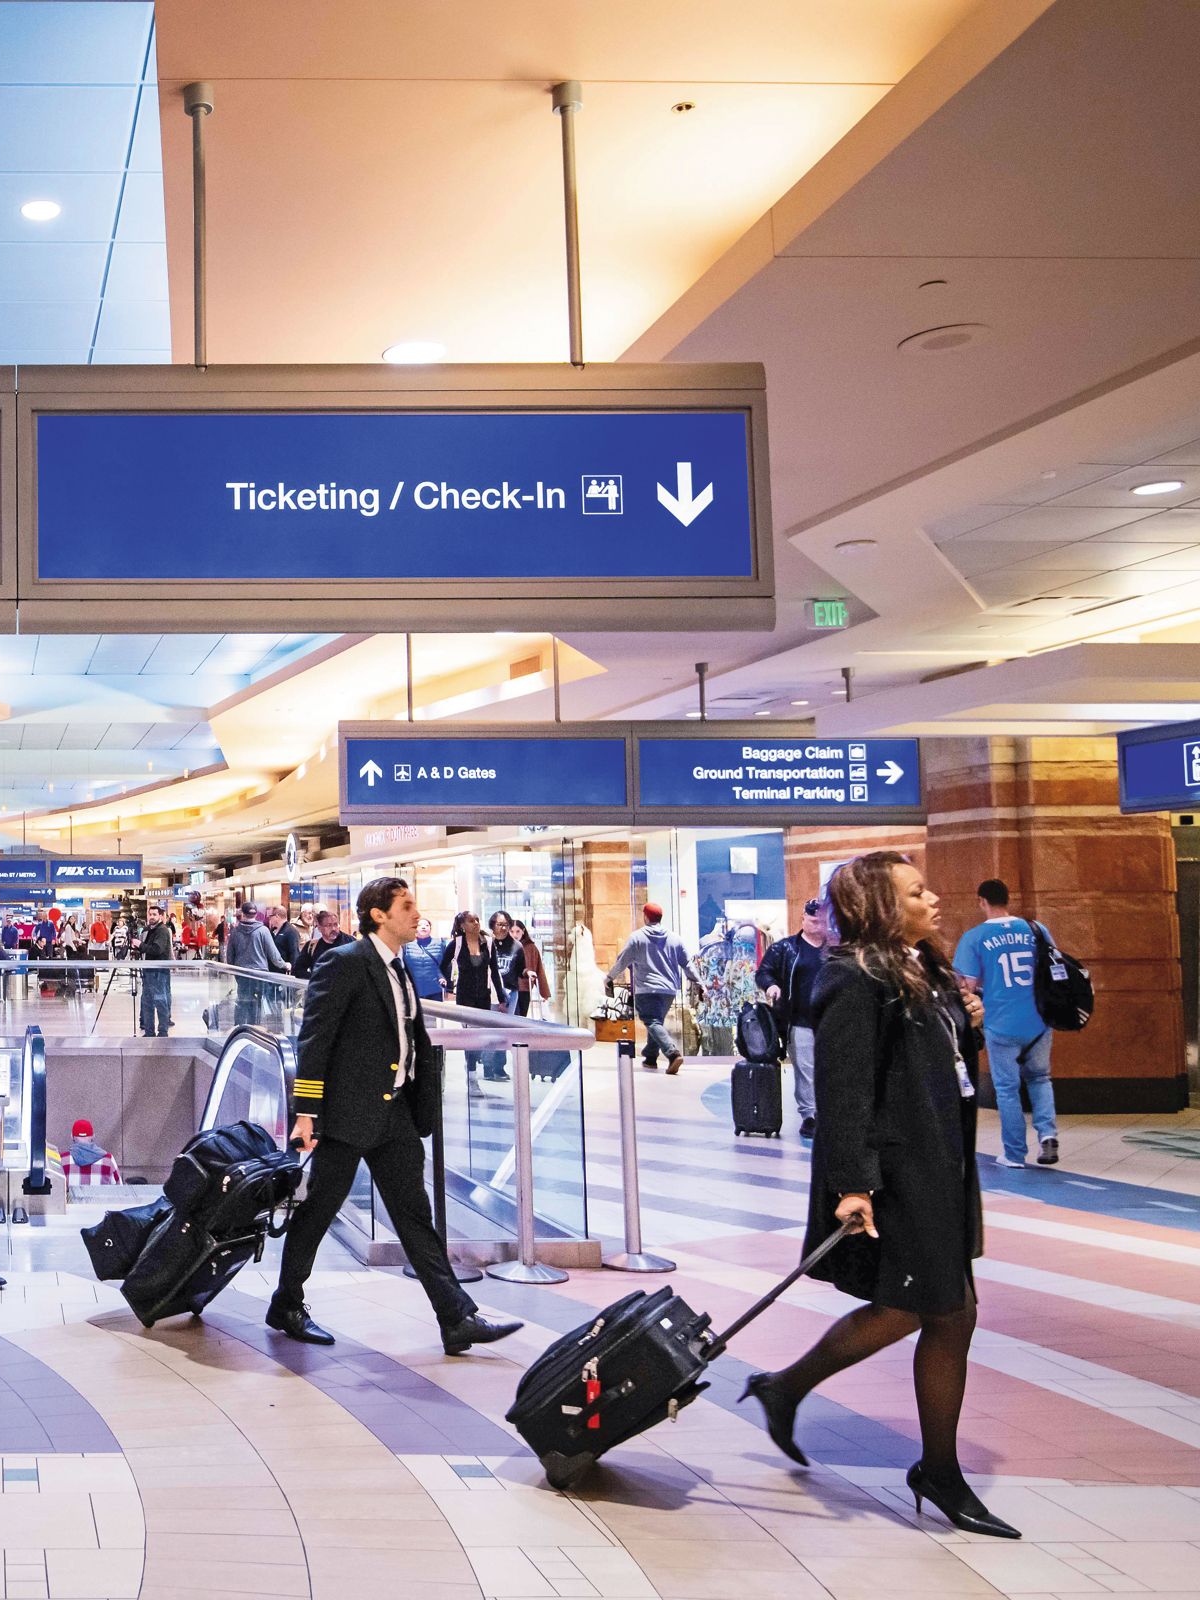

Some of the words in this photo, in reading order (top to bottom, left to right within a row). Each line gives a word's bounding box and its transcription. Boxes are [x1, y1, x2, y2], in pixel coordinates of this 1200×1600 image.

[226, 482, 380, 516] Ticketing
[389, 482, 404, 509] /
[414, 481, 566, 510] Check-In
[814, 602, 844, 627] EXIT
[742, 746, 803, 762] Baggage
[805, 746, 844, 760] Claim
[417, 766, 428, 779] A
[431, 766, 441, 779] &
[444, 766, 454, 779] D
[457, 766, 497, 780] Gates
[692, 766, 743, 780] Ground
[745, 766, 845, 782] Transportation
[732, 786, 791, 800] Terminal
[793, 786, 846, 802] Parking
[56, 866, 87, 876] PHX
[983, 933, 1037, 952] MAHOMES
[997, 950, 1034, 988] 15
